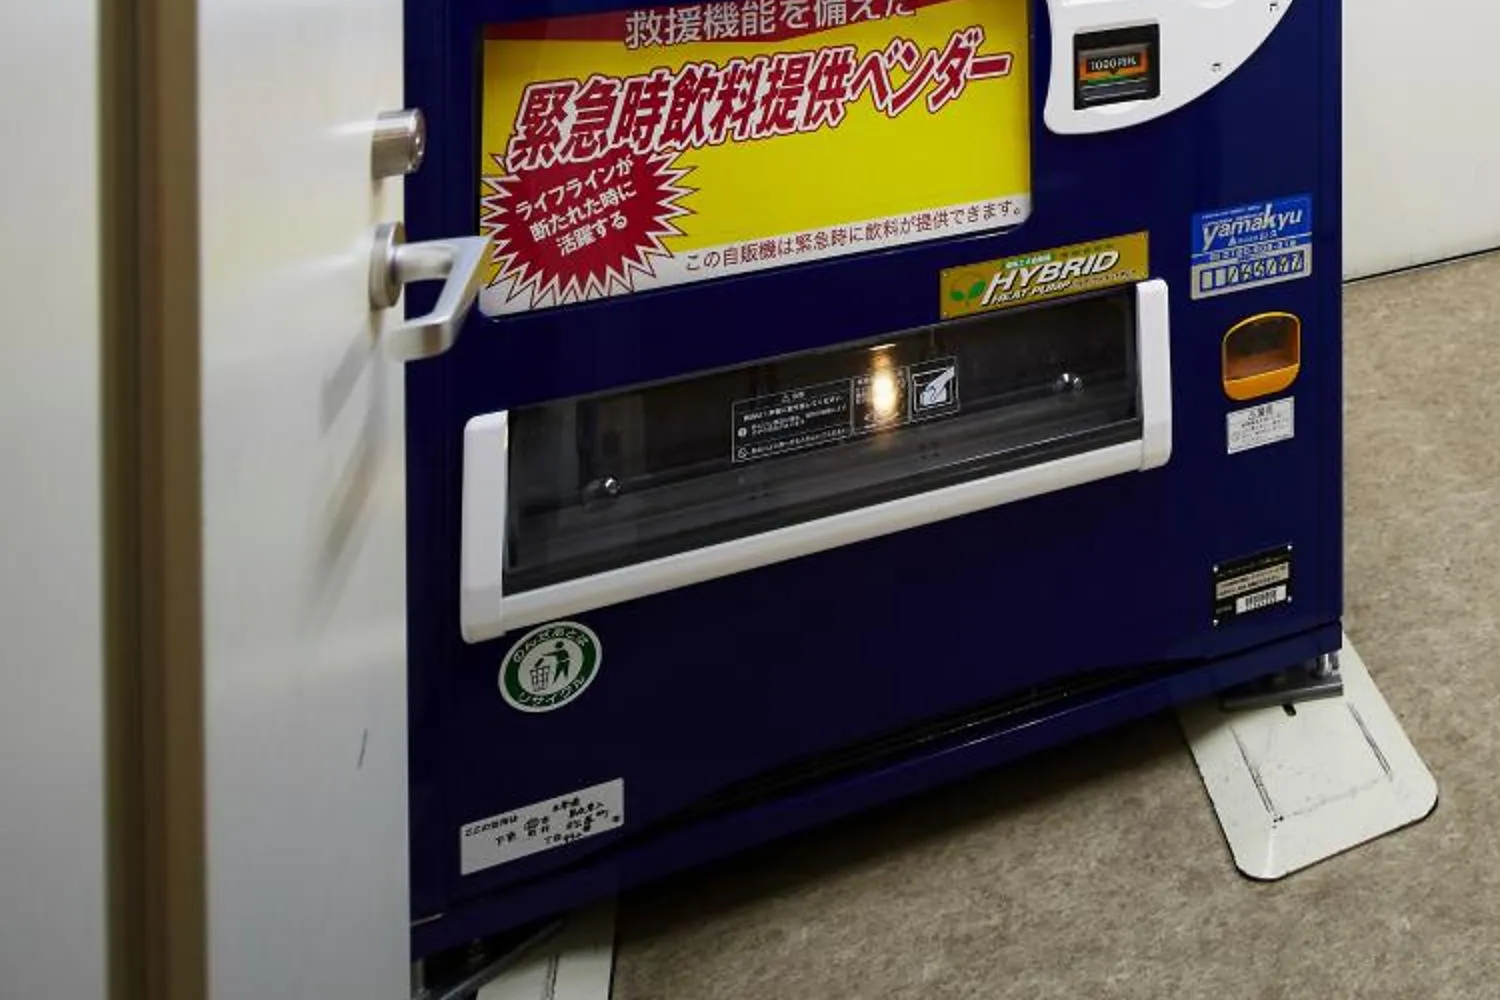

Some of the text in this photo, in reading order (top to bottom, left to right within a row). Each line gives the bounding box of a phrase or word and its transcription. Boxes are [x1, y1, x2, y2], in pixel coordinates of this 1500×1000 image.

[506, 26, 1013, 172] 緊急時飲料提供ベンダー
[515, 154, 634, 221] ライフラインが
[529, 181, 637, 243] 断たれた時に
[557, 210, 628, 256] 活躍する
[686, 200, 1022, 271] この自販機は緊急時に飲料が提供できます。
[1202, 203, 1302, 251] yamakyu
[981, 248, 1120, 305] HYBRID
[993, 280, 1072, 304] HEAT PUMP
